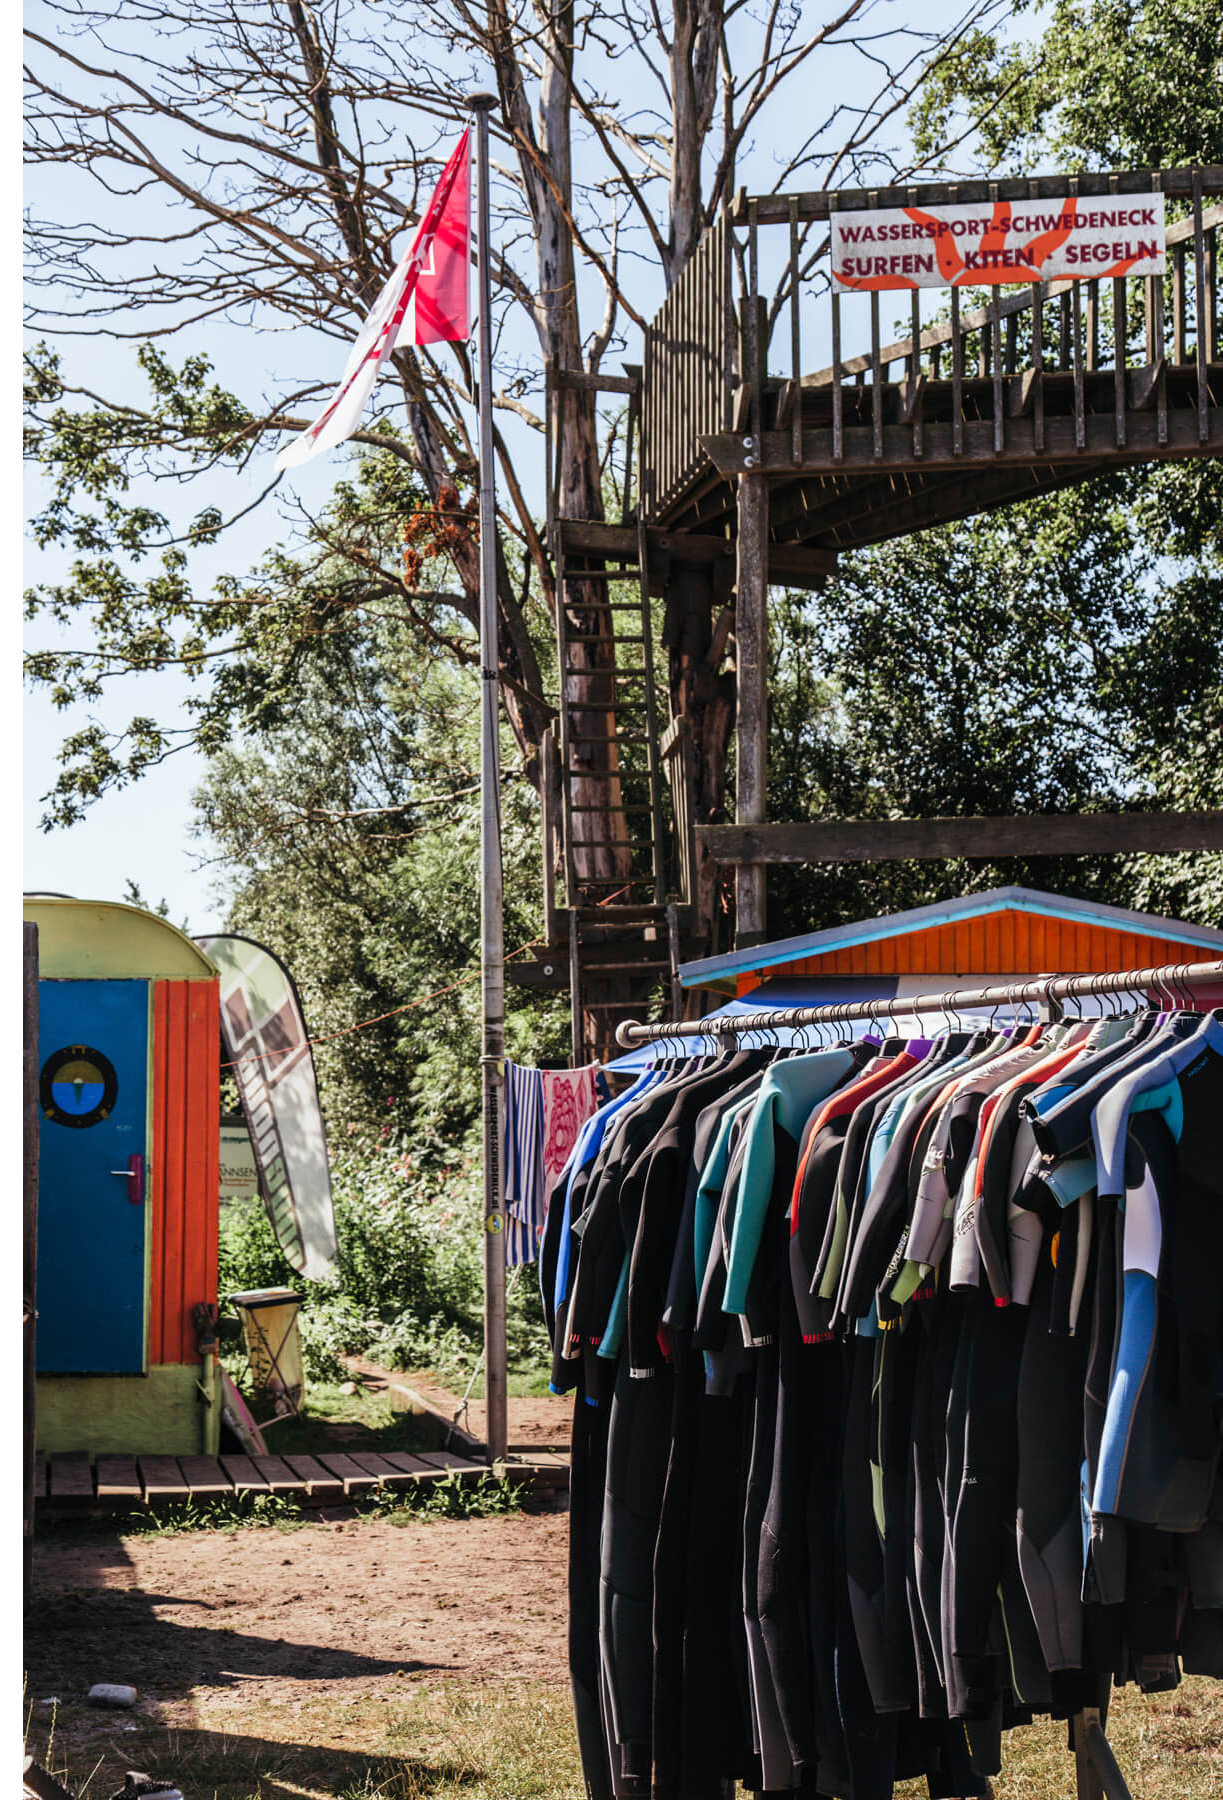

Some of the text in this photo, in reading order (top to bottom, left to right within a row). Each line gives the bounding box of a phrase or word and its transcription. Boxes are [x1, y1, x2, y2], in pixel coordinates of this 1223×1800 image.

[839, 208, 1157, 243] WASSERSPORT-SCHWEDENECK
[841, 240, 1158, 277] SURFEN KITEN SEGELN
